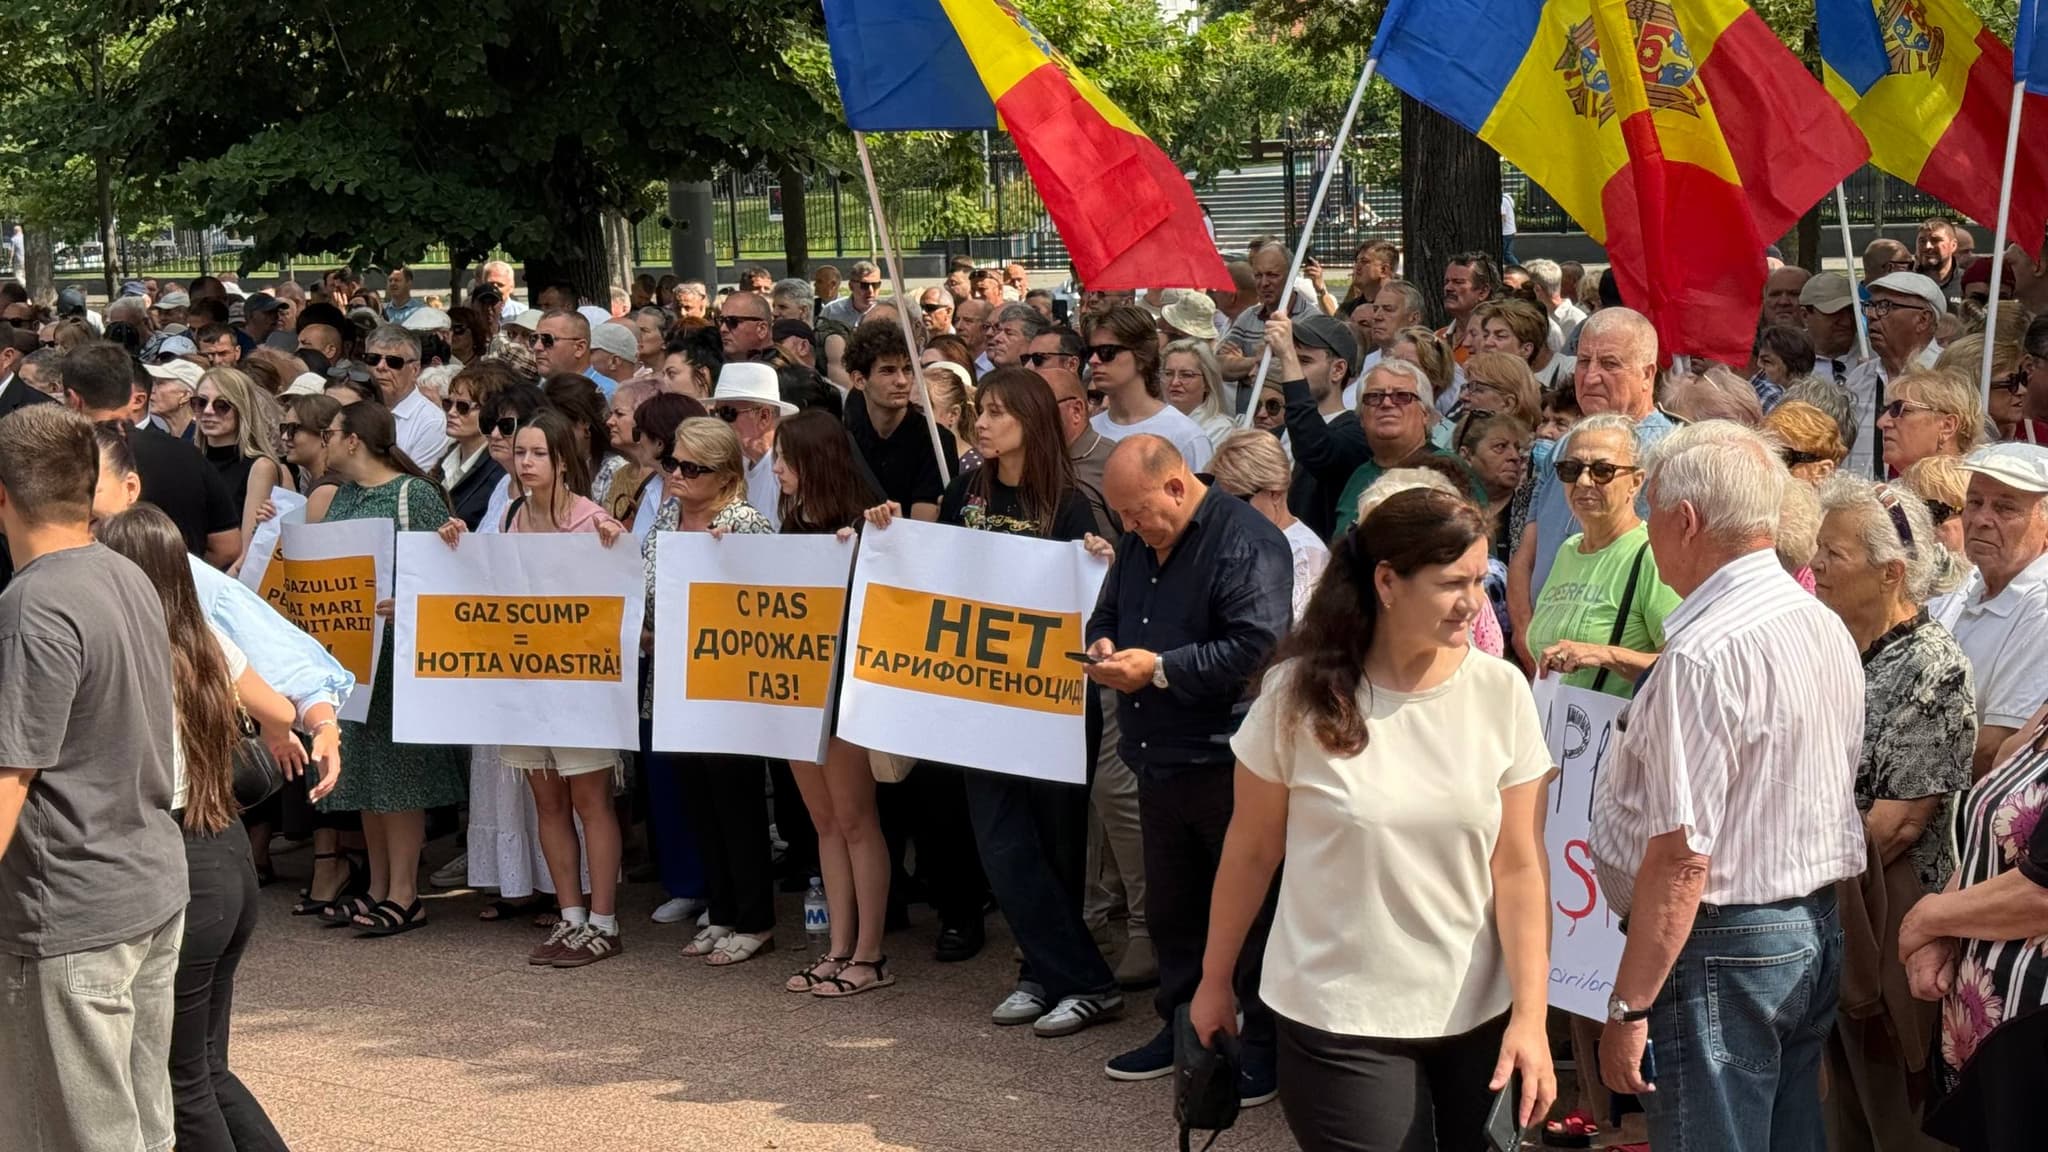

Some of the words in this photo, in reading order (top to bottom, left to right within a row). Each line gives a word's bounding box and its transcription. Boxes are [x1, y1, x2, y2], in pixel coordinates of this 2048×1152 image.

[310, 599, 362, 617] MARI
[454, 602, 500, 622] GAZ
[506, 603, 590, 624] SCUMP
[757, 591, 808, 620] PAS
[925, 598, 1063, 670] НЕТ
[417, 651, 504, 677] HOȚIA
[509, 647, 621, 676] VOASTRĂ!
[748, 670, 800, 701] ГАЗ!
